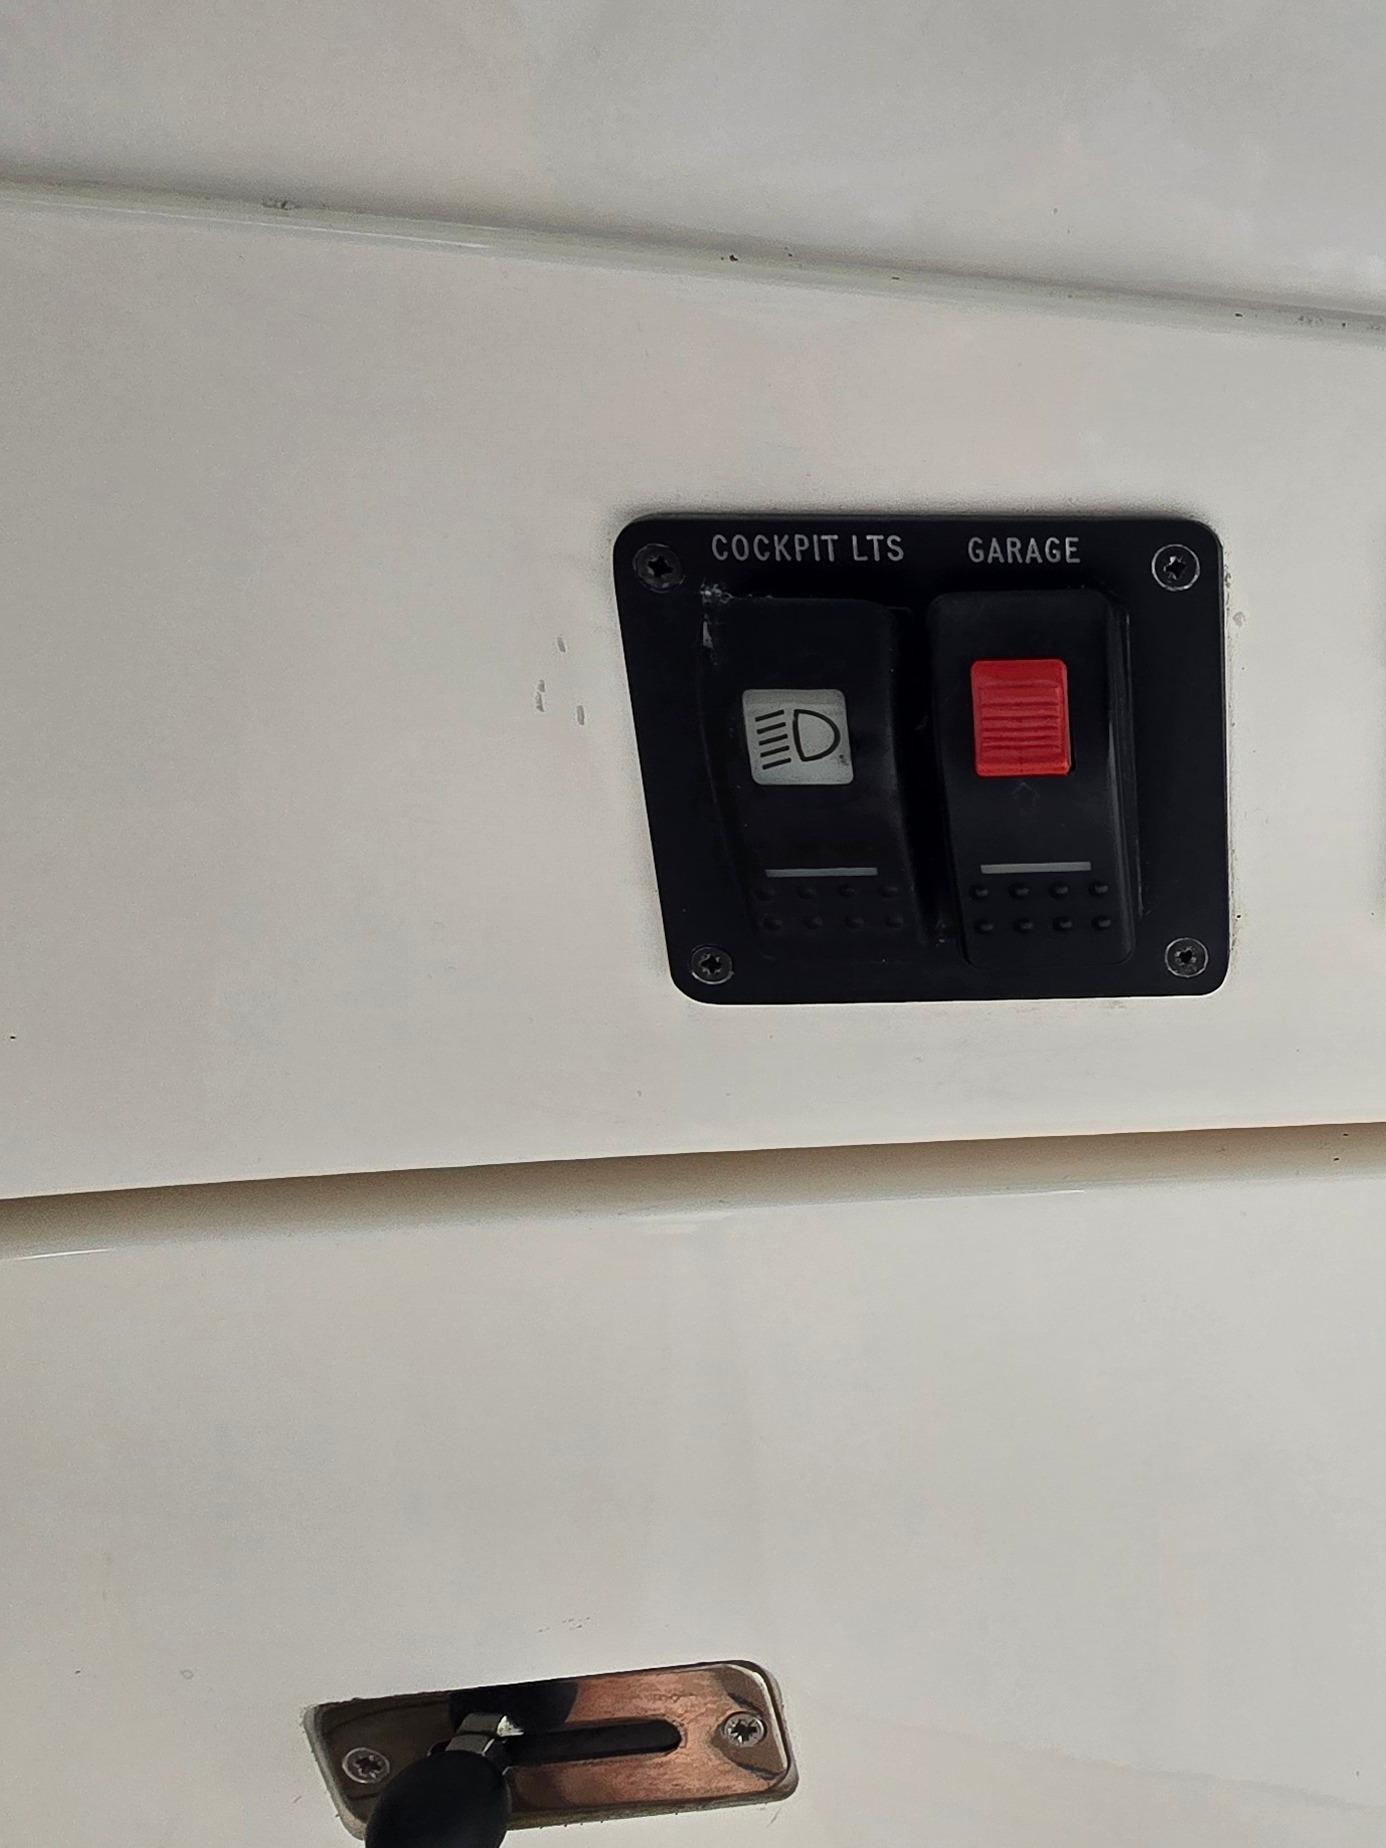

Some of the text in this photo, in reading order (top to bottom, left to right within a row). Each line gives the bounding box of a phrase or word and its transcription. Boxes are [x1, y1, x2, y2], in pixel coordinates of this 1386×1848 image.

[711, 534, 905, 562] COCKPIT LTS
[967, 536, 1081, 564] GARAGE
